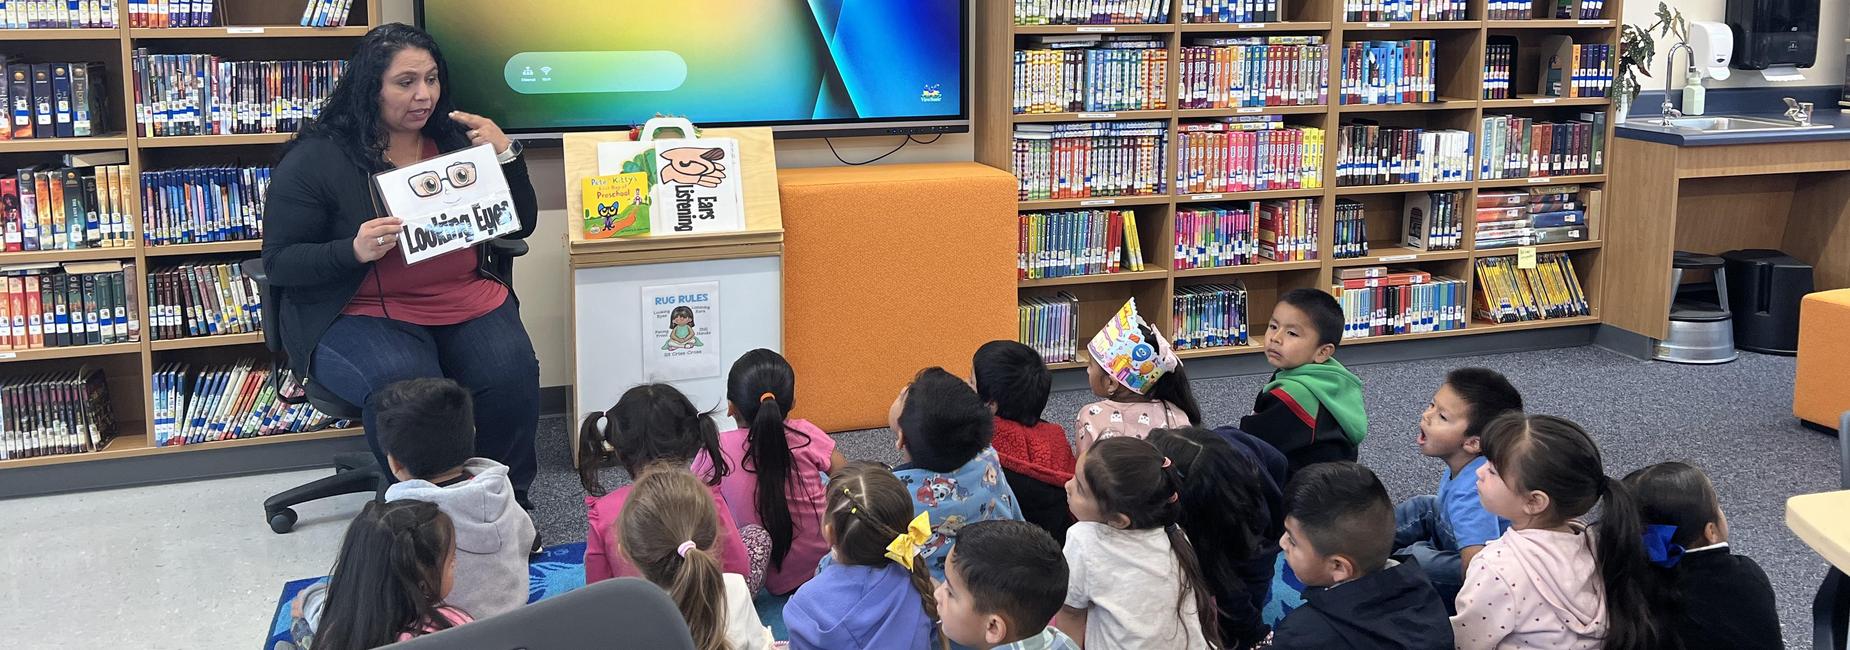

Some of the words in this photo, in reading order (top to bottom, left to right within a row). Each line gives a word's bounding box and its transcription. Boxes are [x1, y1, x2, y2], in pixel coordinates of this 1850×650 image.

[596, 189, 631, 199] Preschool
[674, 184, 696, 232] Listening
[697, 195, 717, 220] Ears
[402, 213, 476, 254] Looking
[471, 200, 513, 235] Eyes
[655, 296, 675, 305] RUG
[678, 294, 708, 303] RULES
